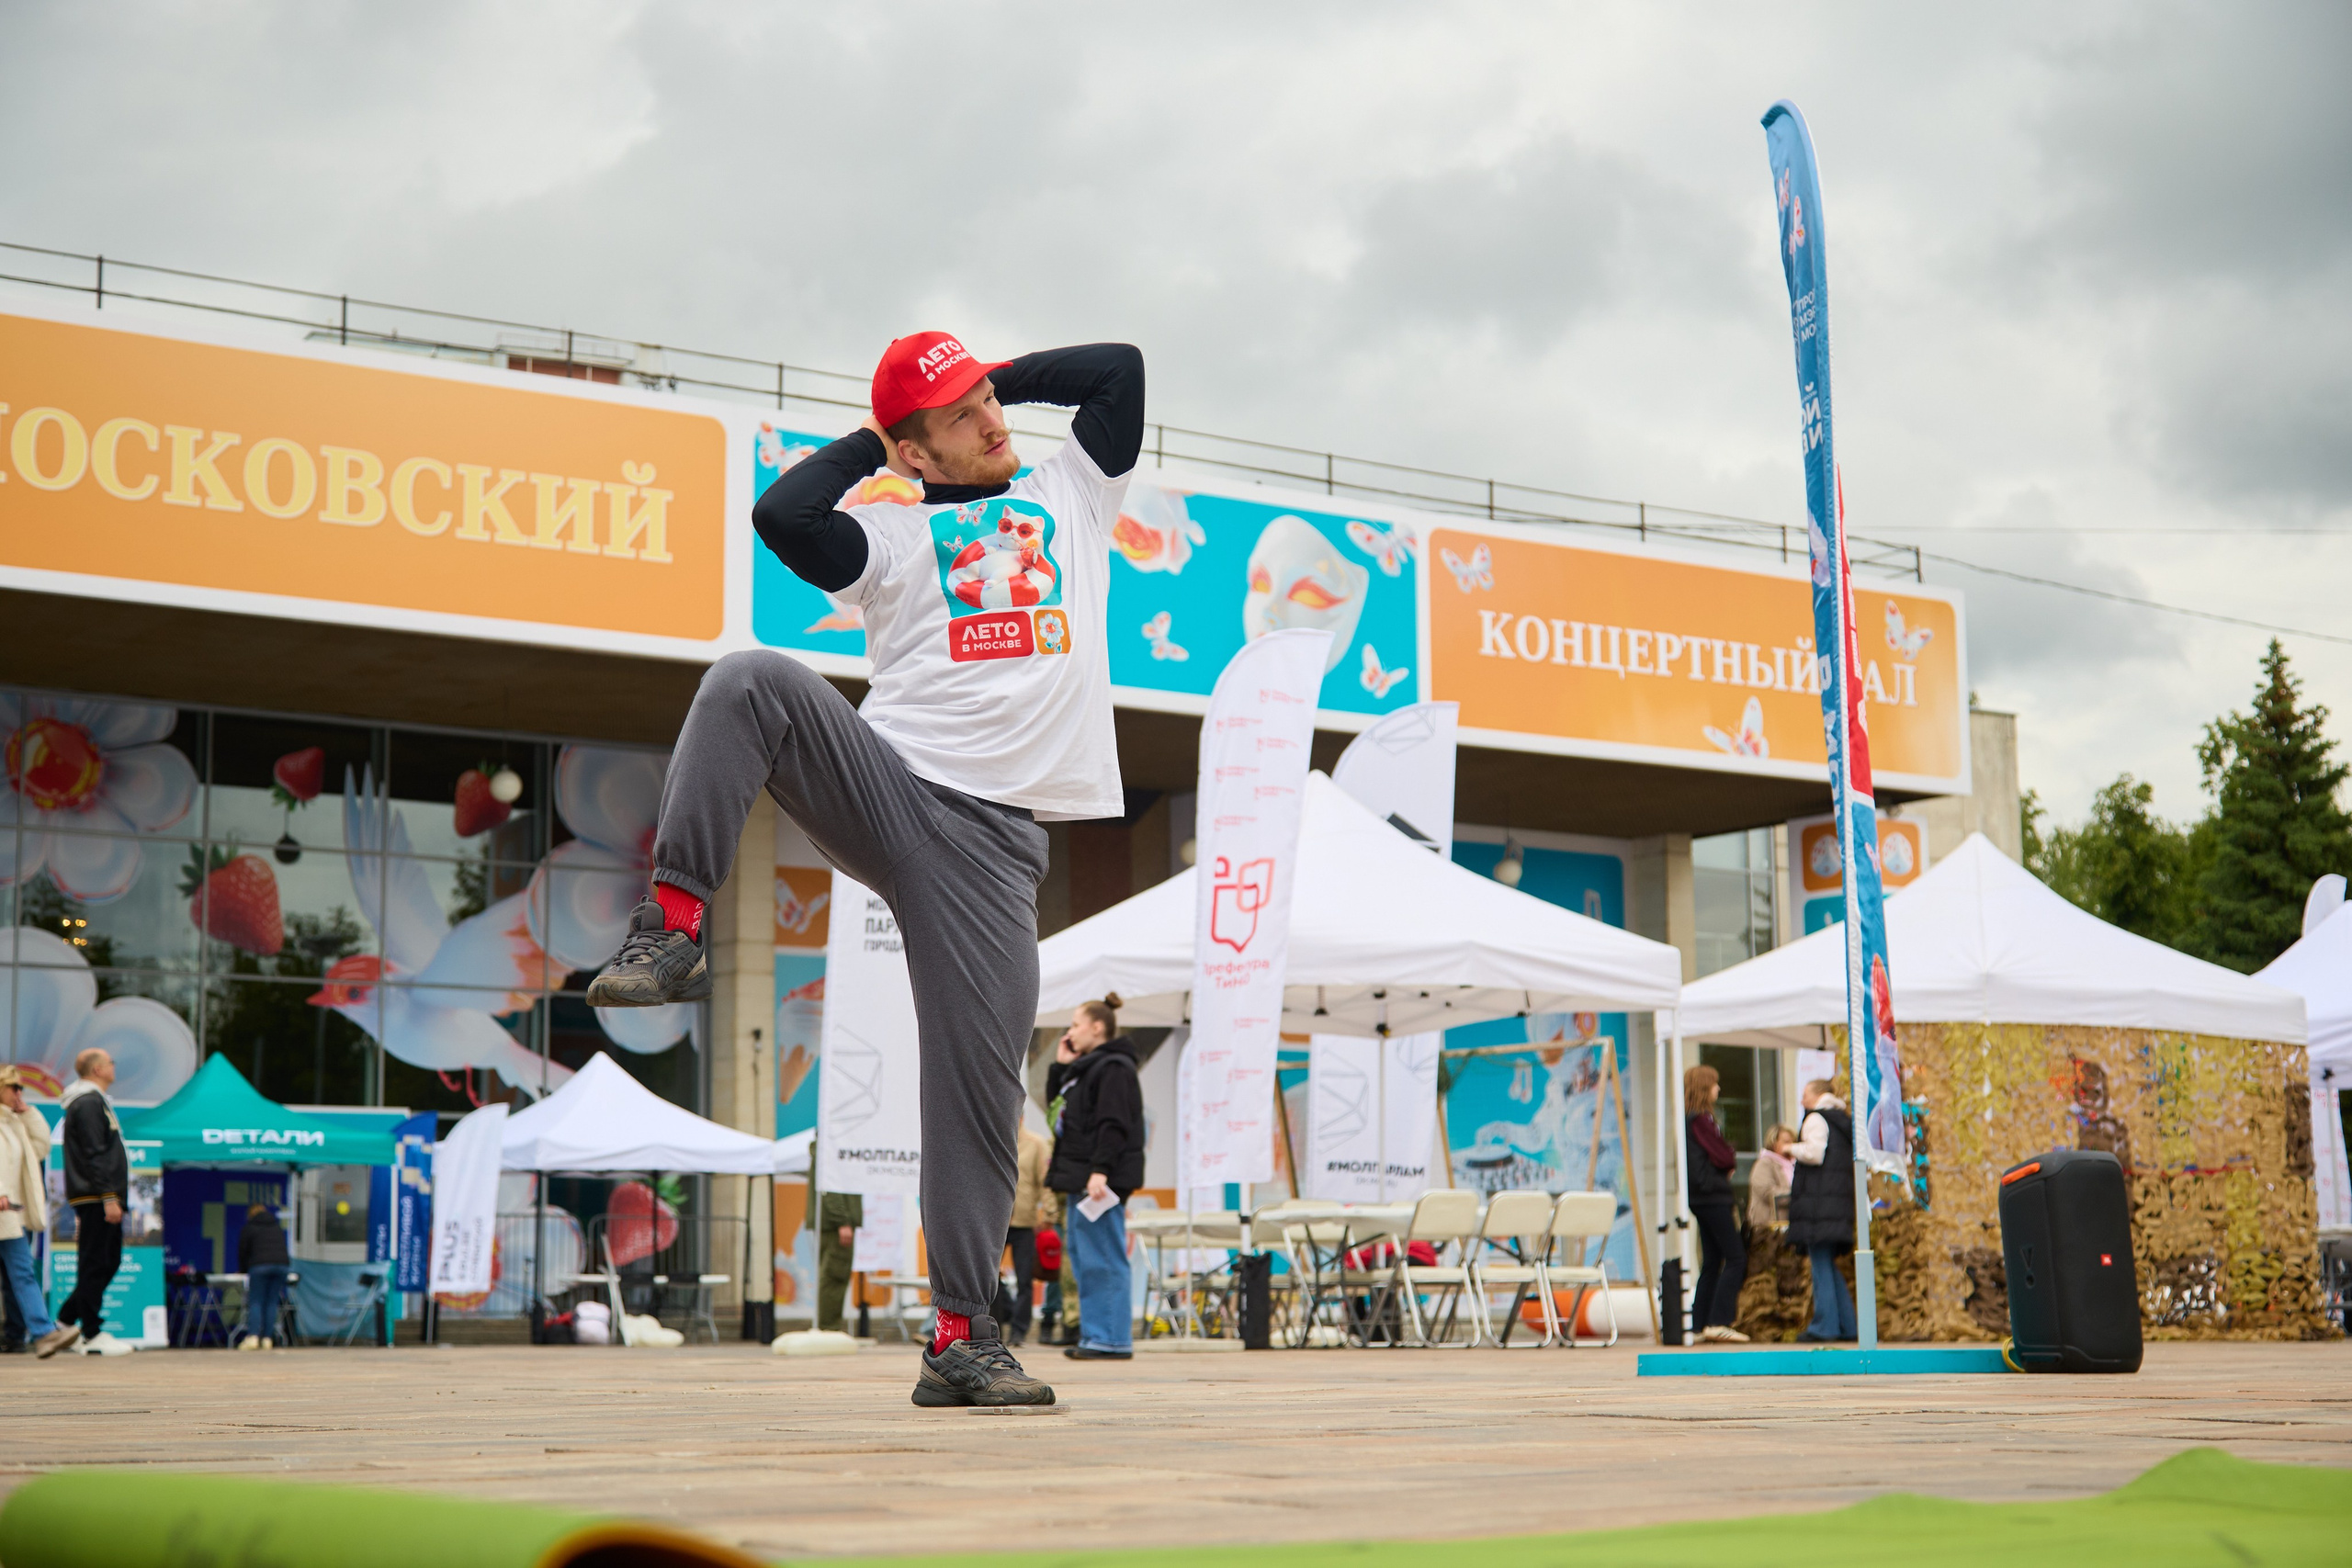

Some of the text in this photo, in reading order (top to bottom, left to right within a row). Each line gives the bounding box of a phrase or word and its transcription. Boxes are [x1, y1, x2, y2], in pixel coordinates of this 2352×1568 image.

[918, 340, 962, 375] ЛЕТО
[0, 401, 674, 563] ОСКОВСКИЙ
[962, 621, 1020, 641] ЛЕТО
[962, 639, 1022, 652] В МОСКВЕ
[1478, 609, 1823, 696] КОНЦЕРТНЫЙ
[1864, 659, 1918, 707] АЛ
